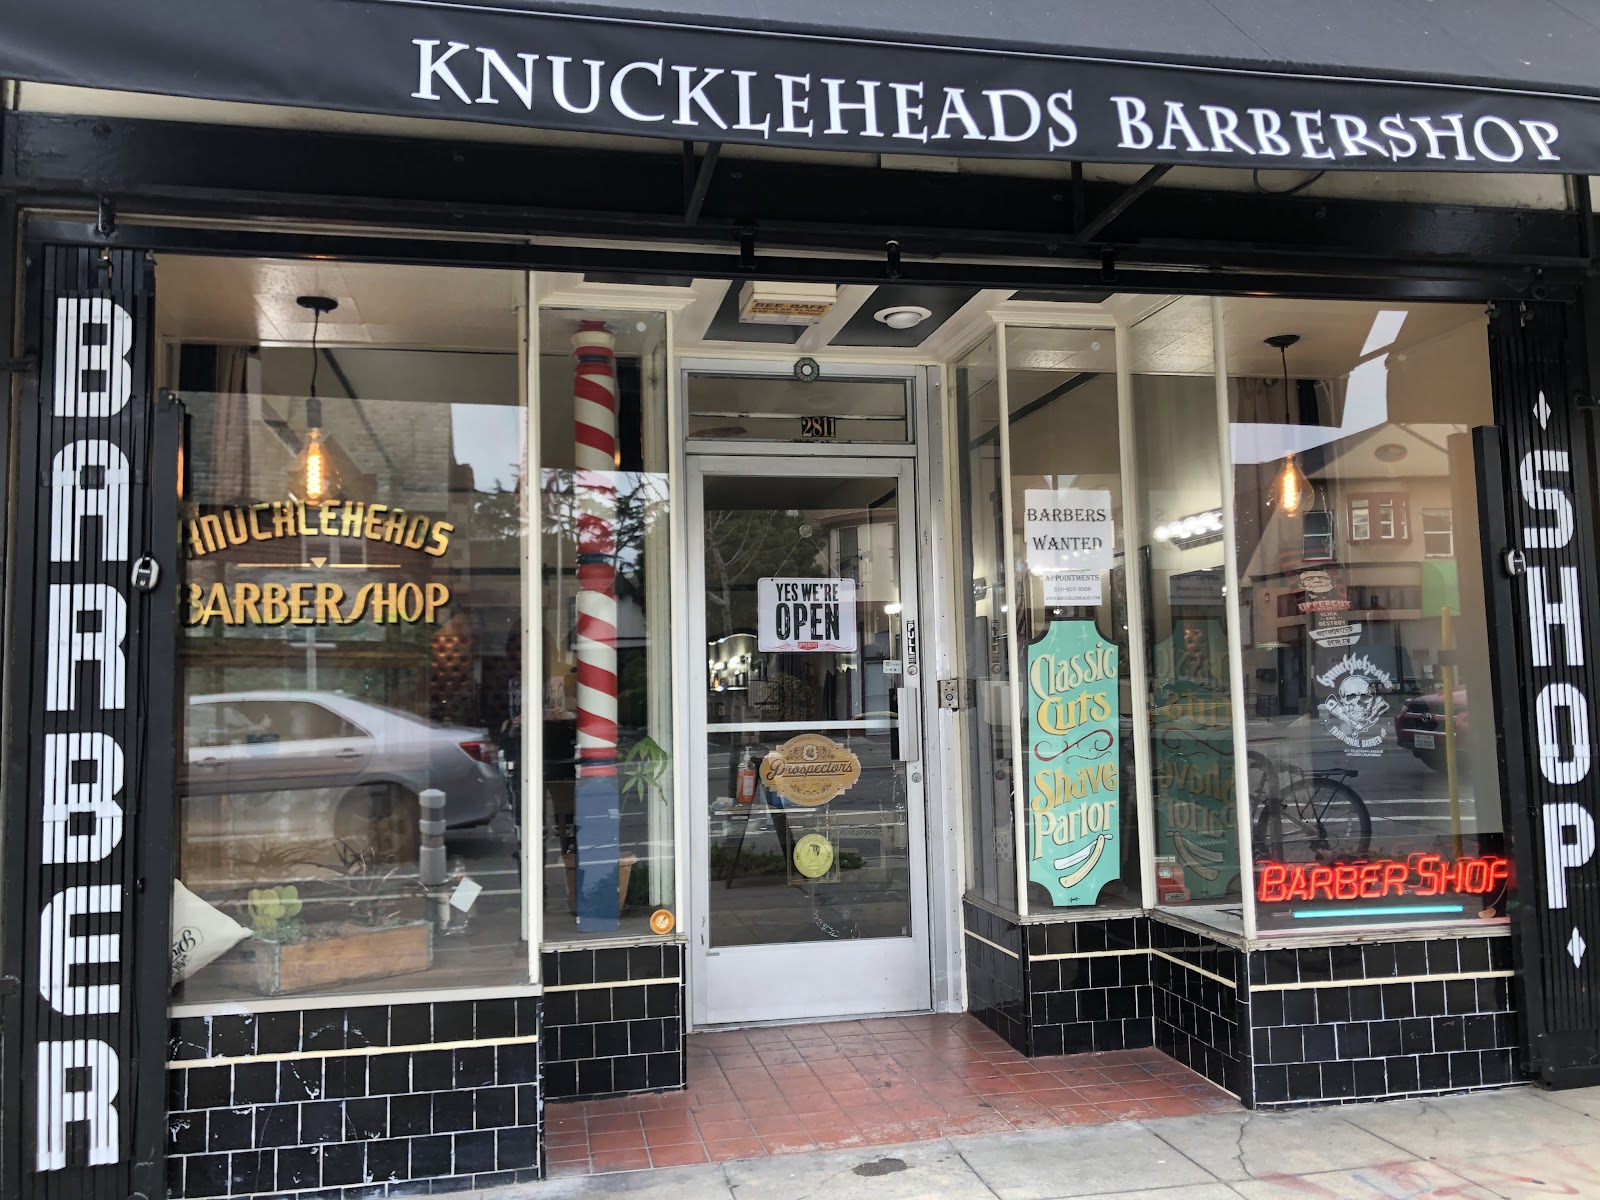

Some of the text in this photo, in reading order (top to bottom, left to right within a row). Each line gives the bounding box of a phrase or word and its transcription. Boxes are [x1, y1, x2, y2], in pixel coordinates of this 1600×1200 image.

[411, 38, 1561, 162] KNUCKLEHEADS BARBERSHOP
[801, 416, 836, 437] 2811
[1027, 508, 1106, 522] BARBERS
[1032, 535, 1102, 550] WANTED
[776, 583, 839, 601] YES WE'RE
[1045, 574, 1100, 582] APPOINTMENTS
[776, 603, 839, 640] OPEN
[1298, 601, 1352, 612] UPPERCUT
[907, 623, 916, 655] PULL
[1316, 626, 1354, 637] AUTHORIZED
[1327, 638, 1351, 647] DEALER
[1030, 642, 1119, 700] Classic
[1519, 448, 1596, 909] SHOP
[1036, 691, 1111, 735] Cuts
[36, 296, 133, 1172] BARBER
[766, 759, 854, 780] Prospectors
[1031, 761, 1118, 813] Shave
[1032, 800, 1117, 861] Parlor
[1260, 864, 1409, 902] BARBER
